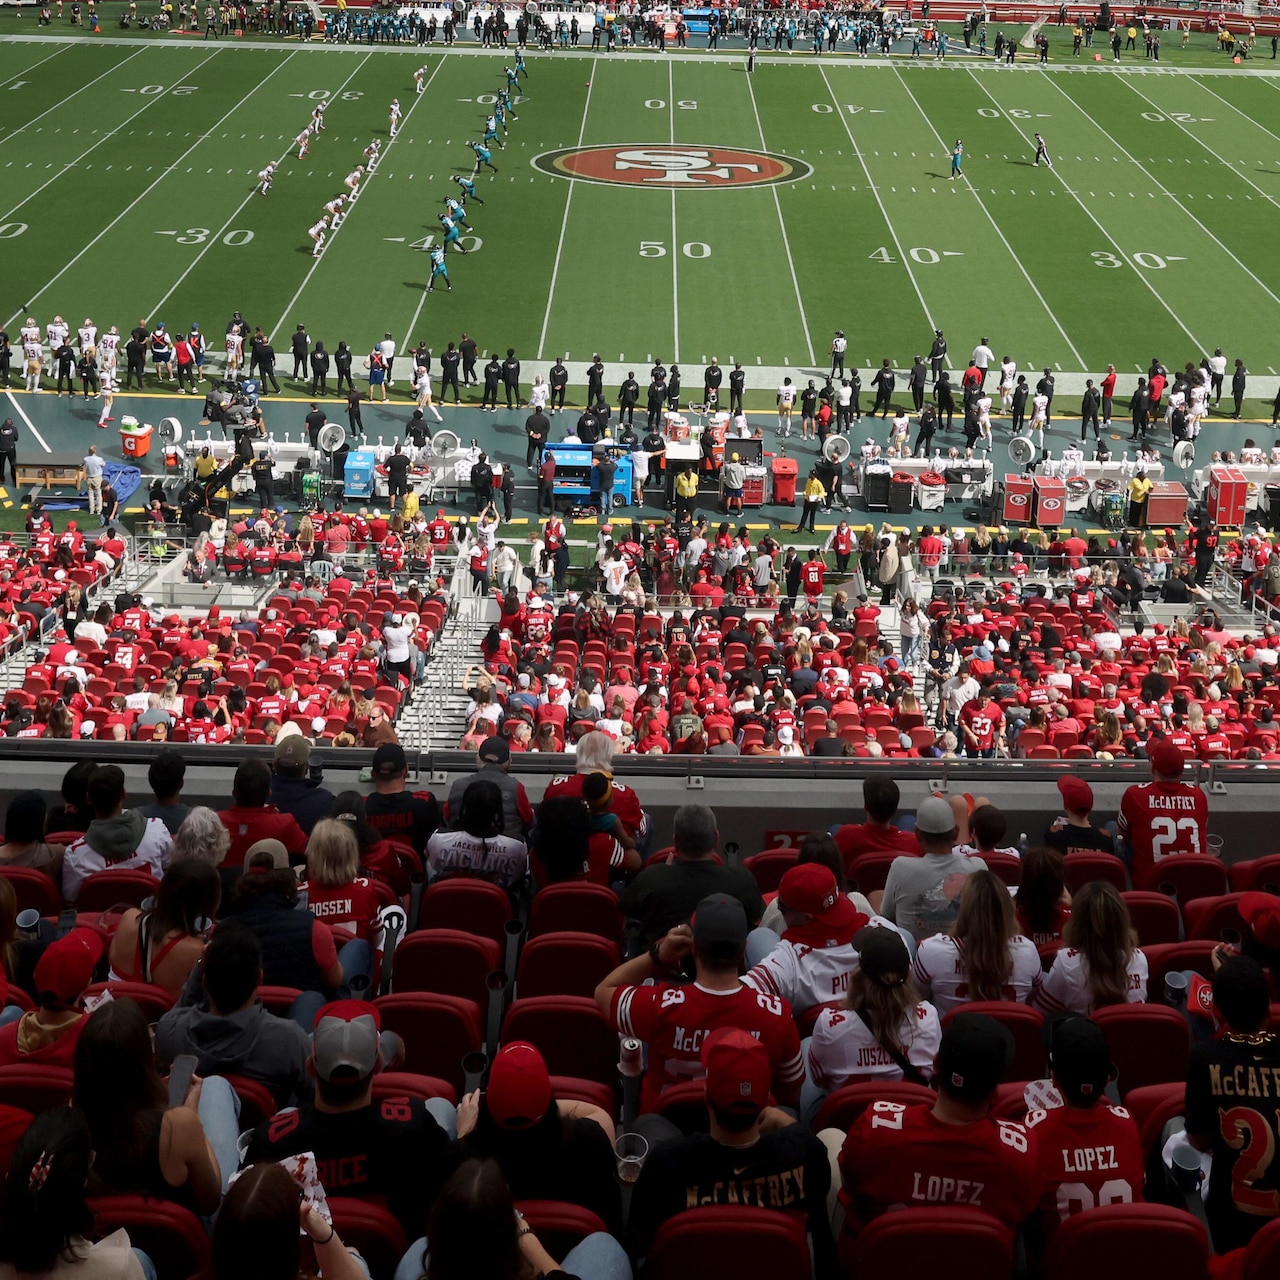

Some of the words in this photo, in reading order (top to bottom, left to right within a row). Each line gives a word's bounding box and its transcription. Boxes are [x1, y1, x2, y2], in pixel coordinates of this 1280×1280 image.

[176, 228, 254, 246] 30
[408, 235, 483, 253] 40
[638, 241, 711, 259] 50
[868, 246, 941, 264] 40
[1091, 250, 1168, 270] 30
[125, 437, 135, 450] G
[1206, 536, 1218, 548] 97
[808, 573, 819, 583] 81
[114, 652, 132, 669] 54
[971, 716, 992, 736] 23
[1148, 795, 1195, 811] McCAFFREY
[451, 841, 507, 854] JACKSONVILLE
[1150, 816, 1200, 863] 23
[433, 848, 518, 875] JAGUARS
[871, 1100, 906, 1131] 87
[1062, 1145, 1118, 1172] LOPEZ
[685, 1164, 805, 1210] McCAFFREY
[911, 1172, 984, 1206] LOPEZ
